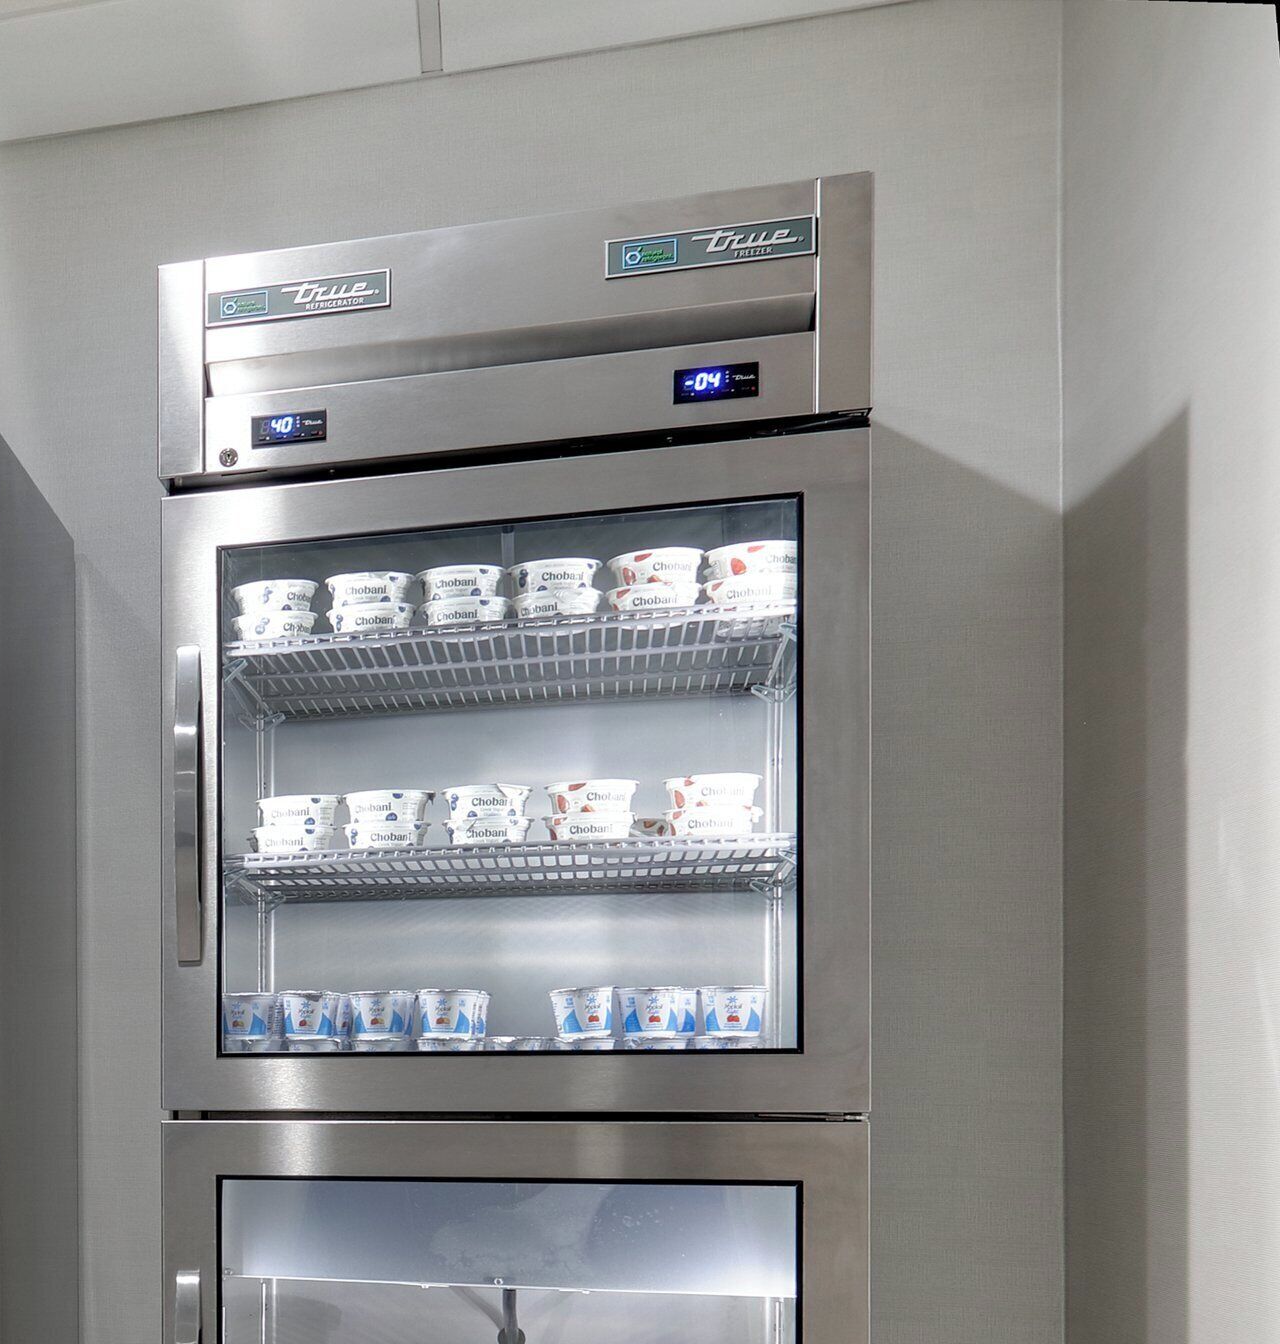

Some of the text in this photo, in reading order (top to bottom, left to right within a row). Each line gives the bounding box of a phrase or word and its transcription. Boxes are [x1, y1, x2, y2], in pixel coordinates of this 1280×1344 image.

[691, 229, 798, 254] true
[734, 246, 773, 259] FREEZER
[281, 282, 375, 304] true
[304, 297, 365, 311] REFRIGERATOR
[683, 371, 722, 392] -04
[270, 415, 294, 434] 40
[652, 561, 692, 573] Chobani
[434, 576, 478, 588] Chobani
[542, 570, 584, 582] Chobani
[345, 584, 387, 596] Chobani
[726, 584, 772, 600] Chobani
[632, 593, 678, 607] Chobani
[436, 608, 478, 622] Chobani
[520, 602, 559, 618] Chobani
[355, 615, 396, 627] Chobani
[271, 806, 310, 819] Chobani
[354, 801, 392, 814] Chobani
[466, 827, 508, 840] Chobani
[569, 823, 614, 836] Chobani
[264, 836, 304, 848] Chobani
[370, 831, 412, 843] Chobani
